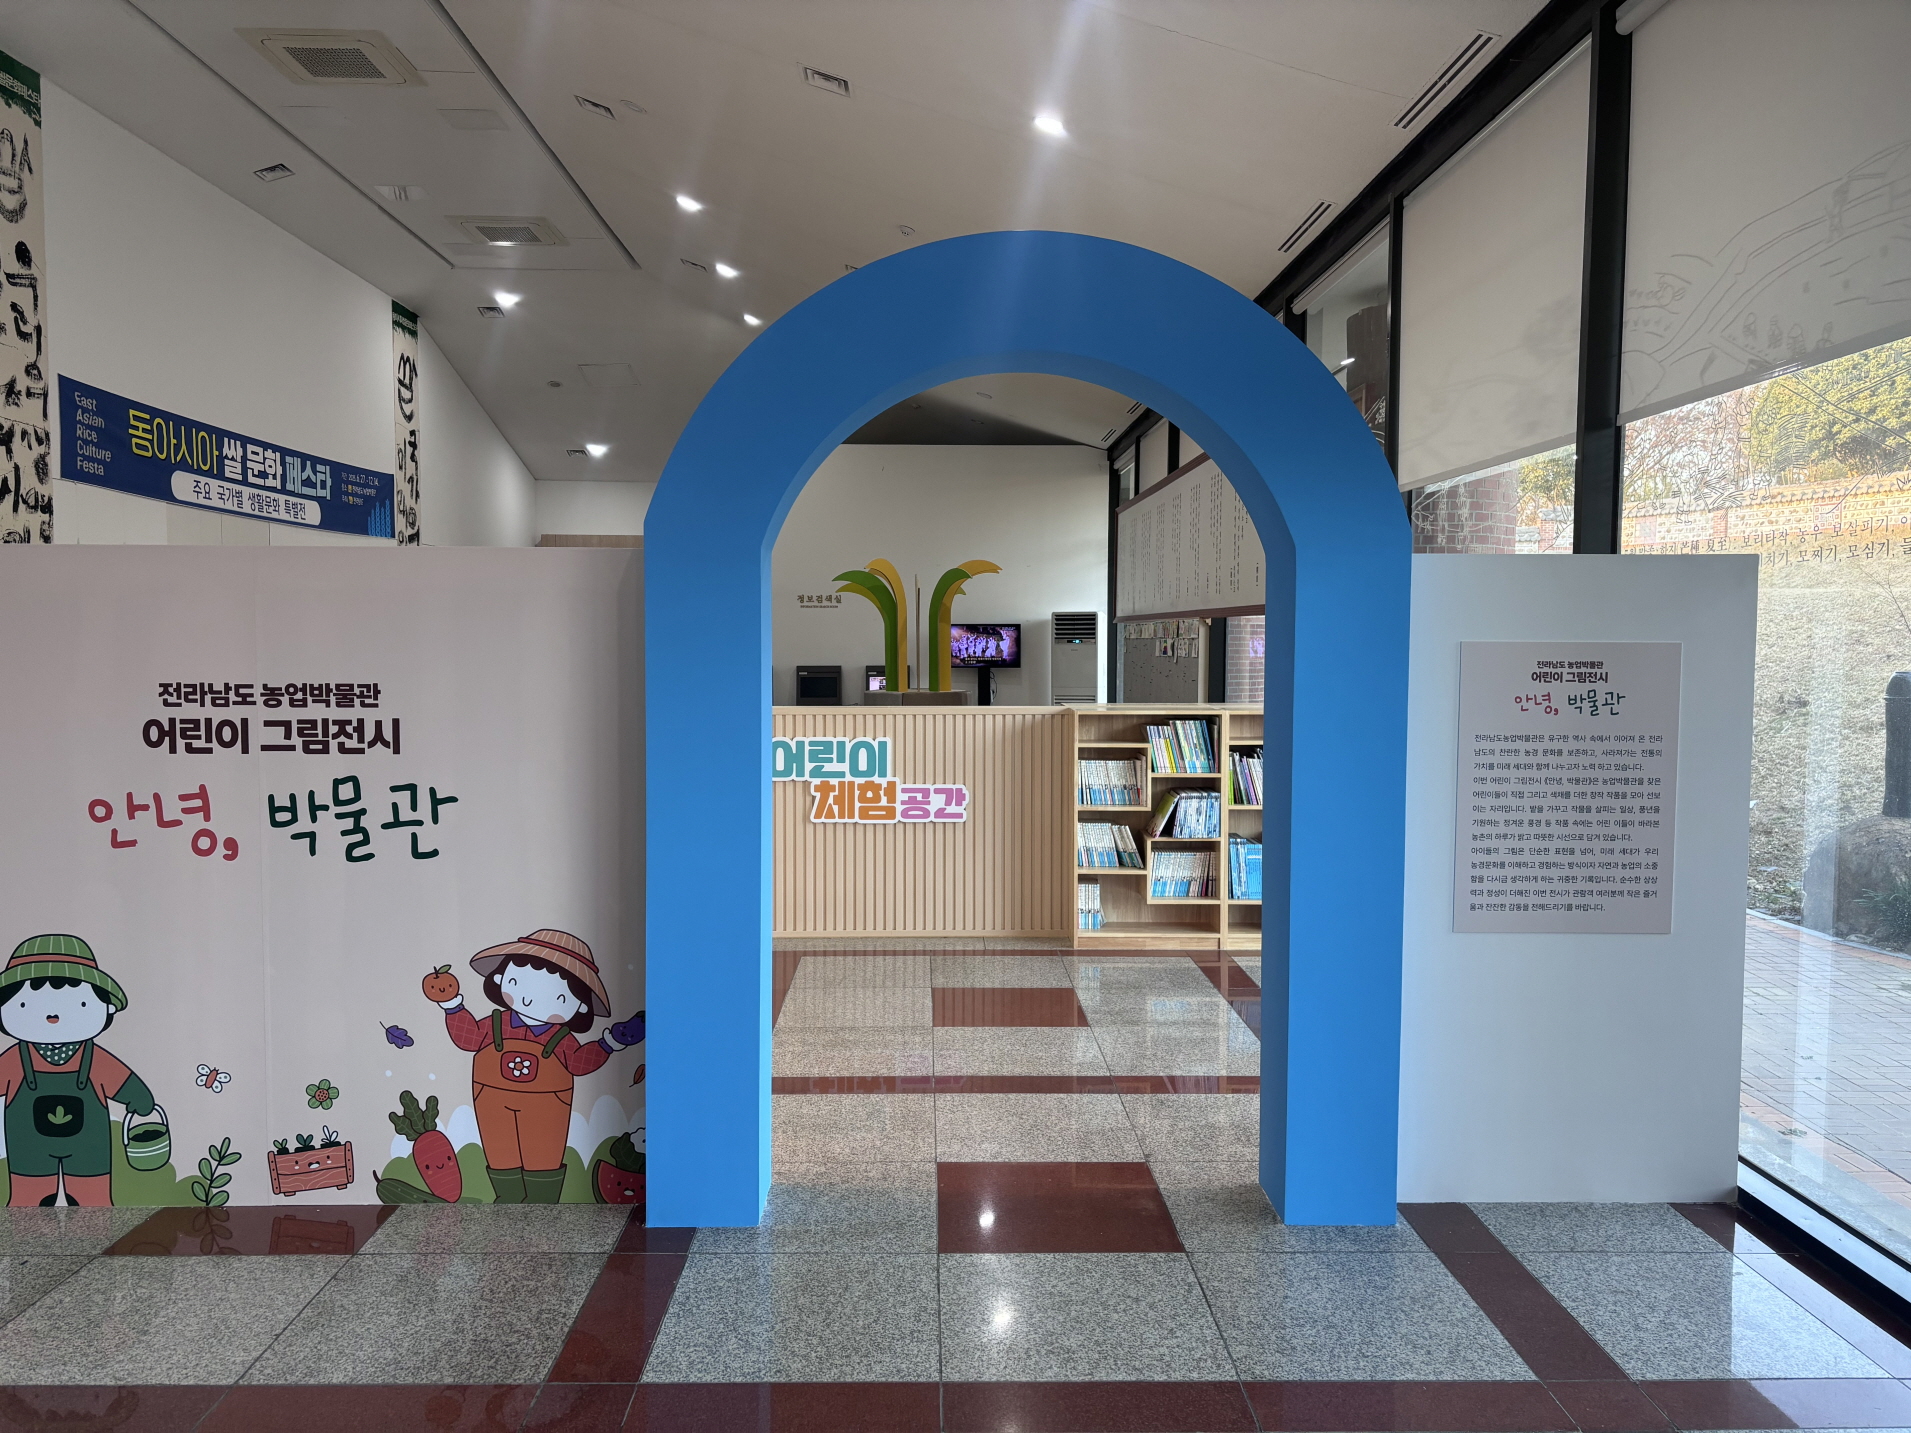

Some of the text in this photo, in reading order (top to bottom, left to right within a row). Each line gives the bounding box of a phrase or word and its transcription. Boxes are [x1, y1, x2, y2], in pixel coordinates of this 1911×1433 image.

[75, 392, 97, 411] East
[76, 409, 104, 428] Asian
[77, 425, 97, 442] Rice
[77, 440, 112, 462] Culture
[128, 408, 332, 500] 동아시아 쌀 문화 페스타
[77, 456, 104, 476] Festa
[192, 480, 307, 520] 주요 국가별 생활문화 특별전
[1741, 529, 1793, 548] 보리타작,
[1797, 545, 1842, 564] 모찌기,
[1846, 539, 1895, 559] 모심기,
[797, 594, 842, 603] 정보검색실
[1536, 660, 1603, 670] 전라남도 농업박물관
[1531, 672, 1608, 683] 어린이 그림전시
[158, 681, 381, 708] 전라남도 농업박물관
[1514, 689, 1626, 716] 안녕, 박물관
[142, 716, 401, 755] 어린이 그림전시
[1475, 734, 1545, 742] 전라남도농업박물관은
[1638, 735, 1645, 743] 온
[1649, 735, 1663, 743] 전라
[1474, 748, 1495, 756] 남도의
[1542, 749, 1563, 757] 문화를
[1567, 749, 1597, 758] 보존하고,
[1601, 749, 1637, 757] 사라져가는
[1641, 749, 1662, 757] 전통의
[772, 740, 888, 778] 어린이
[1536, 763, 1550, 771] 함께
[1614, 763, 1644, 771] 있습니다.
[1514, 777, 1541, 785] 그림전시
[1602, 777, 1644, 785] 농업박물관을
[1473, 791, 1508, 799] 어린이들이
[1511, 791, 1524, 799] 직접
[1527, 791, 1548, 799] 그리고
[1550, 791, 1571, 799] 색채를
[1590, 791, 1604, 799] 창작
[1630, 792, 1644, 800] 모아
[1490, 805, 1526, 813] 자리입니다.
[1530, 805, 1544, 813] 밭을
[1620, 806, 1635, 814] 일상,
[1639, 806, 1660, 814] 풍년을
[88, 775, 458, 863] 안녕, 박물관
[1472, 819, 1500, 827] 기원하는
[1504, 819, 1524, 827] 정겨운
[1528, 819, 1541, 827] 풍경
[1638, 820, 1660, 828] 바라본
[1472, 833, 1492, 841] 농촌의
[1471, 847, 1499, 855] 아이들의
[1503, 847, 1525, 855] 그림은
[1529, 847, 1550, 855] 단순한
[1554, 847, 1575, 855] 표현을
[1580, 848, 1595, 856] 넘어,
[1644, 848, 1658, 856] 우리
[1471, 861, 1506, 869] 농경문화를
[1508, 861, 1536, 869] 이해하고
[1621, 862, 1642, 870] 농업의
[1644, 862, 1658, 870] 소중
[1471, 875, 1484, 883] 함을
[1487, 875, 1508, 883] 다시금
[1510, 875, 1538, 883] 생각하게
[1470, 889, 1484, 897] 력과
[1486, 889, 1507, 897] 정성이
[1485, 903, 1506, 911] 잔잔한
[1508, 903, 1529, 911] 감동을
